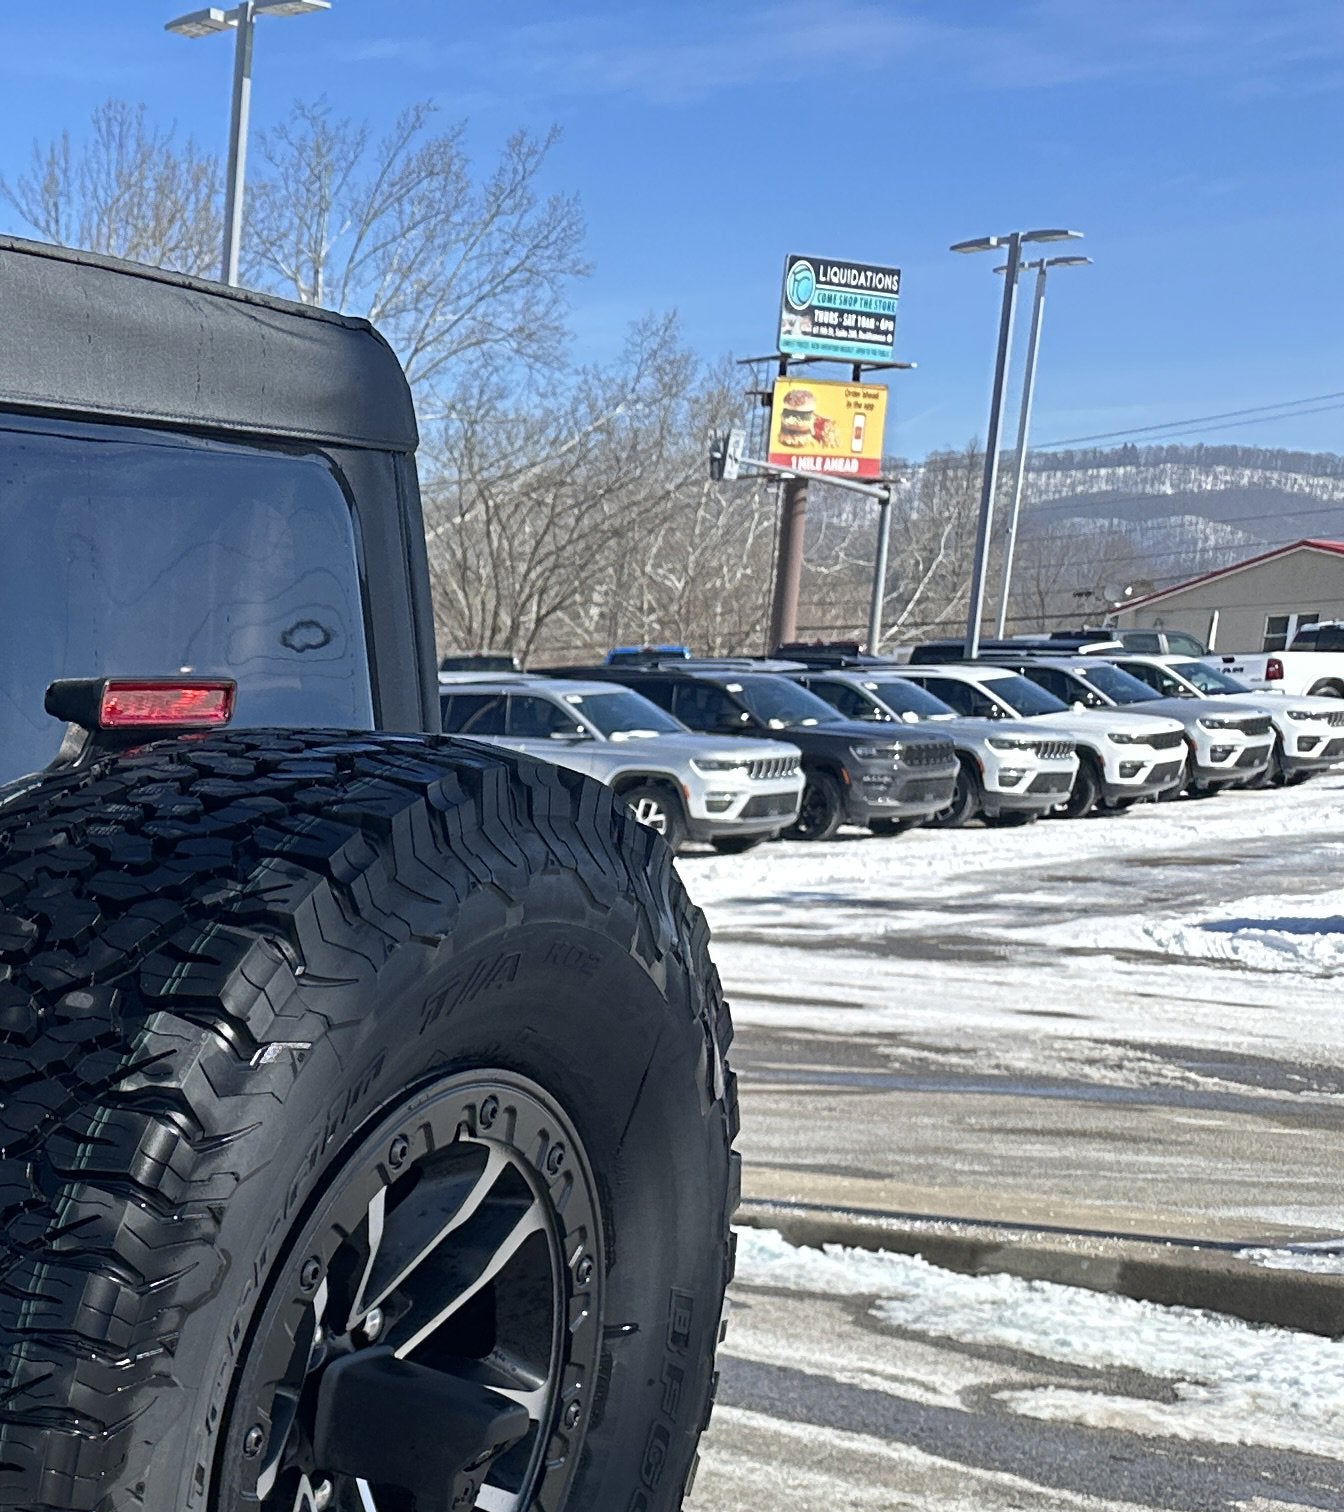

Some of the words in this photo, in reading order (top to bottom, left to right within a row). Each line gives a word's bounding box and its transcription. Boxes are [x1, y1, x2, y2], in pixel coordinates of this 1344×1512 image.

[819, 265, 899, 292] LIQUIDATIONS
[817, 292, 838, 306] COME
[838, 294, 858, 308] SHOP
[859, 297, 873, 310] THE
[874, 298, 896, 313] STORE
[814, 309, 839, 325] THURS
[842, 313, 857, 327] SAT
[791, 456, 797, 469] 1
[798, 456, 823, 471] MILE
[823, 457, 859, 473] AHEAD
